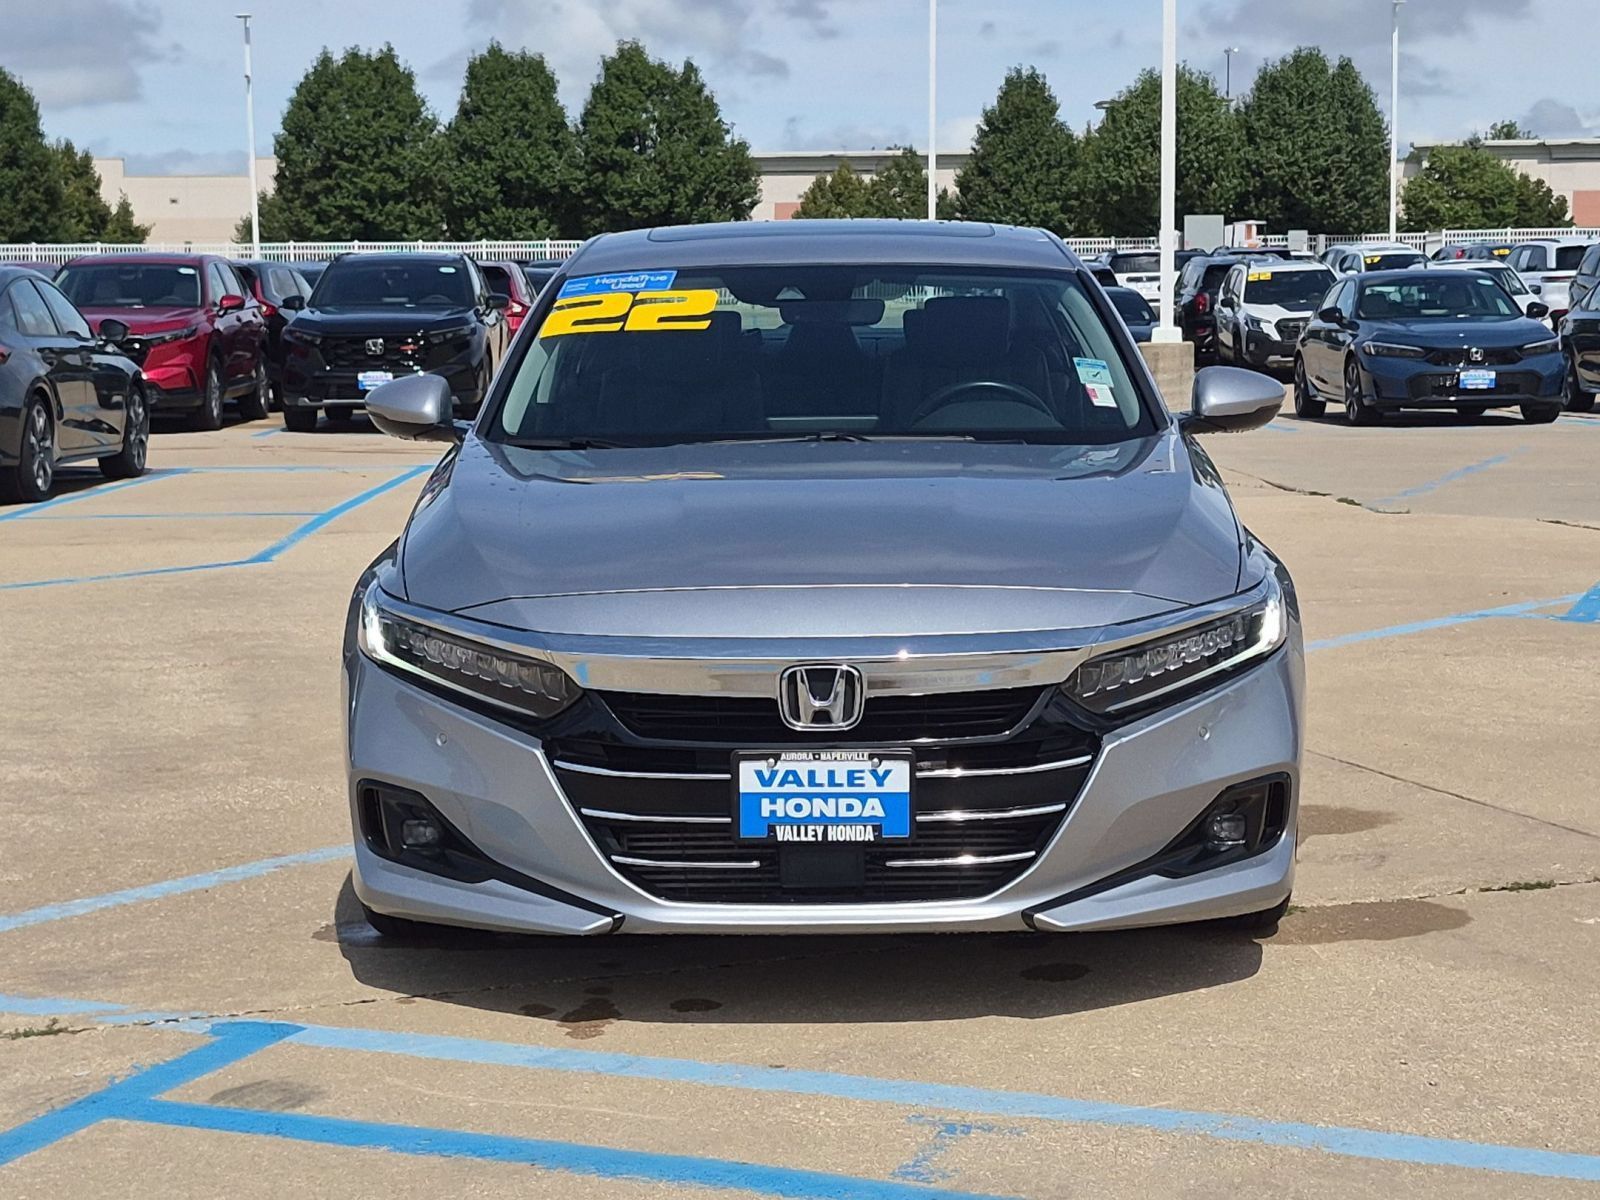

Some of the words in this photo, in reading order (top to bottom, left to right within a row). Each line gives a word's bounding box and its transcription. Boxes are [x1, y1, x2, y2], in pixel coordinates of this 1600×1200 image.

[595, 274, 668, 285] HondaTrue
[611, 281, 646, 290] Used
[539, 289, 718, 339] 22
[780, 752, 814, 761] AURORA
[820, 752, 869, 761] NAPERVILLE
[753, 768, 894, 788] VALLEY
[760, 797, 886, 818] HONDA
[775, 824, 825, 842] VALLEY
[826, 824, 875, 842] HONDA
